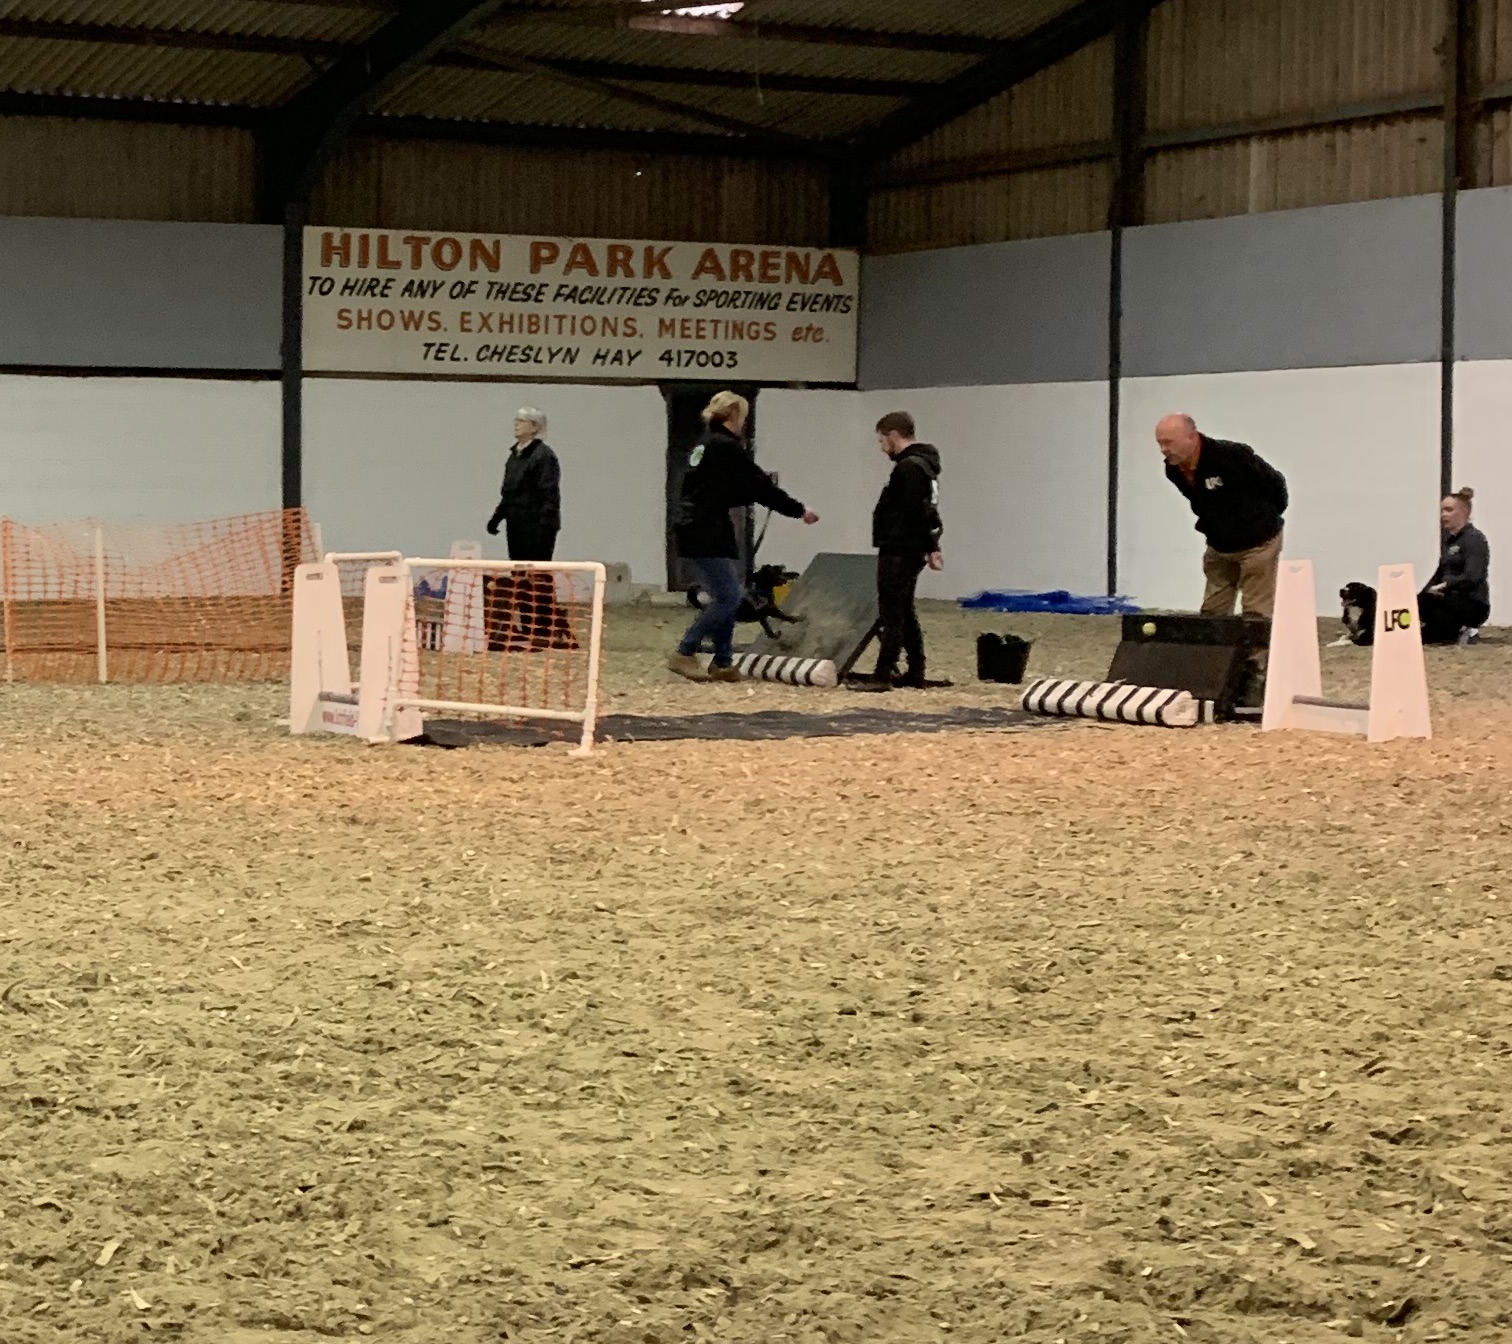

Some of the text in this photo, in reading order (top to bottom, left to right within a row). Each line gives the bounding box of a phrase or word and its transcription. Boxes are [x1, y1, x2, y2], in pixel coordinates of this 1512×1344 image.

[320, 231, 844, 286] HILTON PARK ARENA
[308, 276, 335, 296] TO
[339, 277, 396, 298] HIRE
[400, 279, 445, 299] ANY
[449, 280, 478, 300] OF
[485, 280, 549, 303] THESE
[552, 283, 660, 307] FACILITIES
[693, 289, 782, 311] SPORTING
[786, 292, 854, 314] EVENTS
[658, 317, 777, 341] MEETINGS
[422, 342, 738, 368] TEL. CHESLYN HAY 417003
[1384, 609, 1410, 632] LFC
